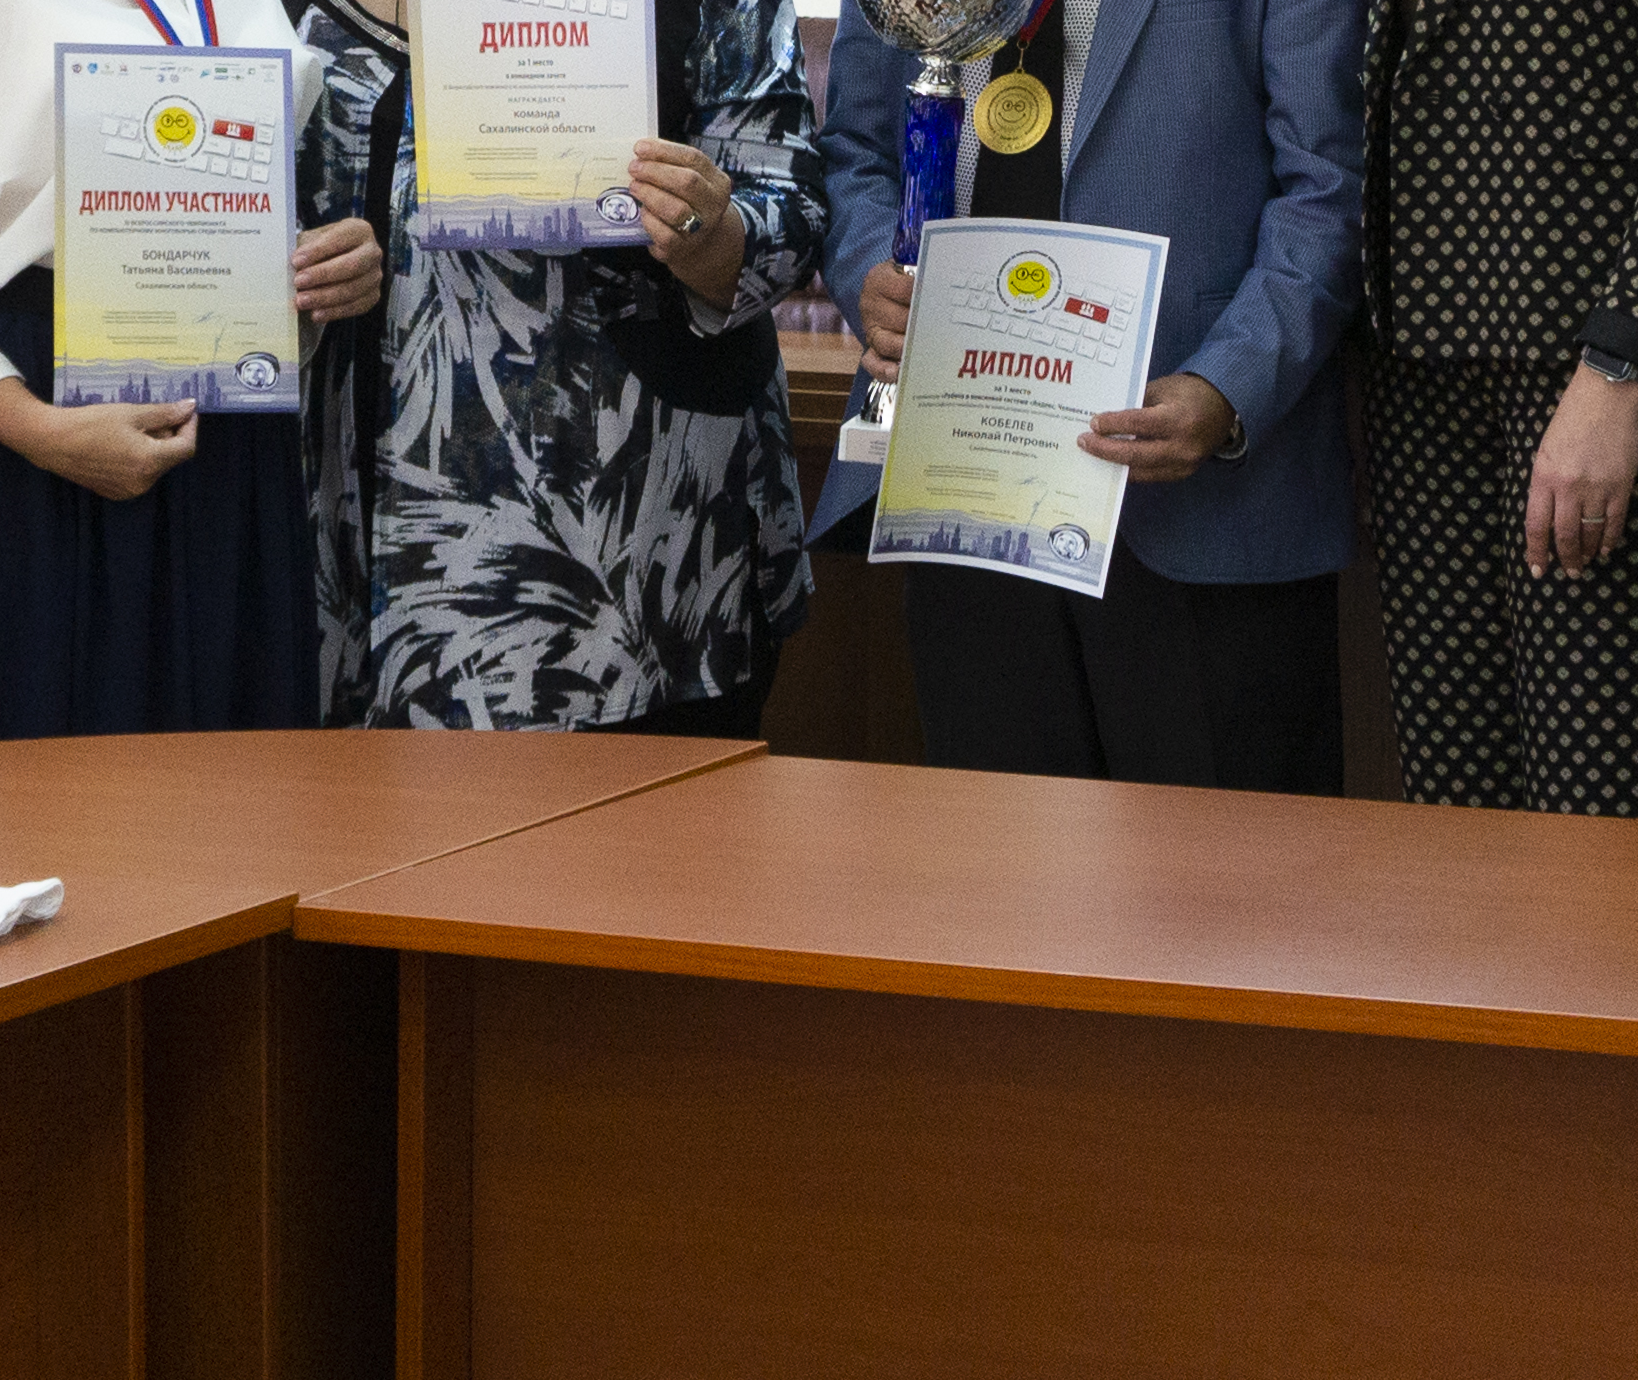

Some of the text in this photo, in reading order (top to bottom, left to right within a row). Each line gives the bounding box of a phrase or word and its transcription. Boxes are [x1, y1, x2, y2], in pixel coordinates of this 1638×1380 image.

[479, 21, 590, 53] ДИПЛОМ
[517, 58, 554, 67] за 1 место
[508, 96, 566, 104] НАГРАЖДАЕТСЯ
[513, 110, 561, 120] команда
[478, 123, 596, 134] Сахалинской области
[79, 190, 272, 215] ДИПЛОМ УЧАСТНИКА
[142, 250, 210, 262] БОНДАРЧУК
[121, 264, 232, 276] Татьяна Васильевна
[957, 349, 1074, 384] ДИПЛОМ
[1004, 385, 1008, 393] 1
[980, 416, 1034, 432] КОБЕЛЕВ
[951, 428, 1060, 451] Николай Петрович
